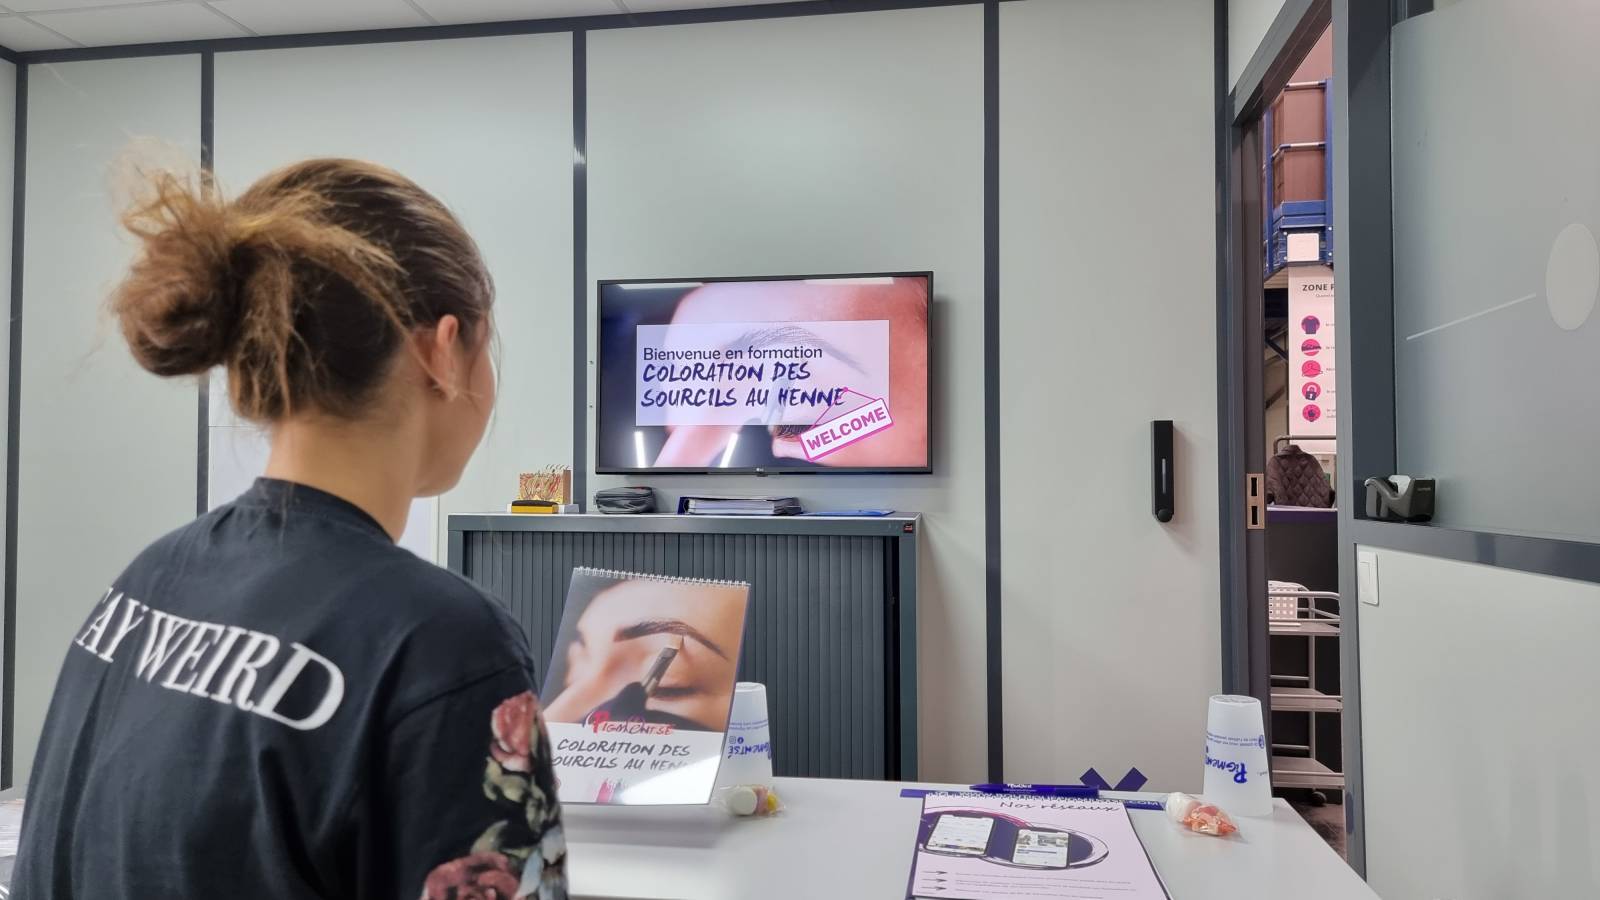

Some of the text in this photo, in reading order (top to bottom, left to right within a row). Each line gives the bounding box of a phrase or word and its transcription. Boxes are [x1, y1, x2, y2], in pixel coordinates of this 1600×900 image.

[643, 345, 823, 361] Bienvenue en formation
[642, 361, 811, 383] COLORATION DES
[640, 387, 737, 407] SOURCILS
[745, 388, 769, 407] AU
[806, 407, 887, 451] WELCOME
[75, 587, 345, 731] AY WEIRD
[557, 738, 690, 757] COLORATION DES
[551, 755, 689, 771] OURCILS AU HEN
[1000, 801, 1035, 809] Nos
[1041, 801, 1121, 812] réseaux
